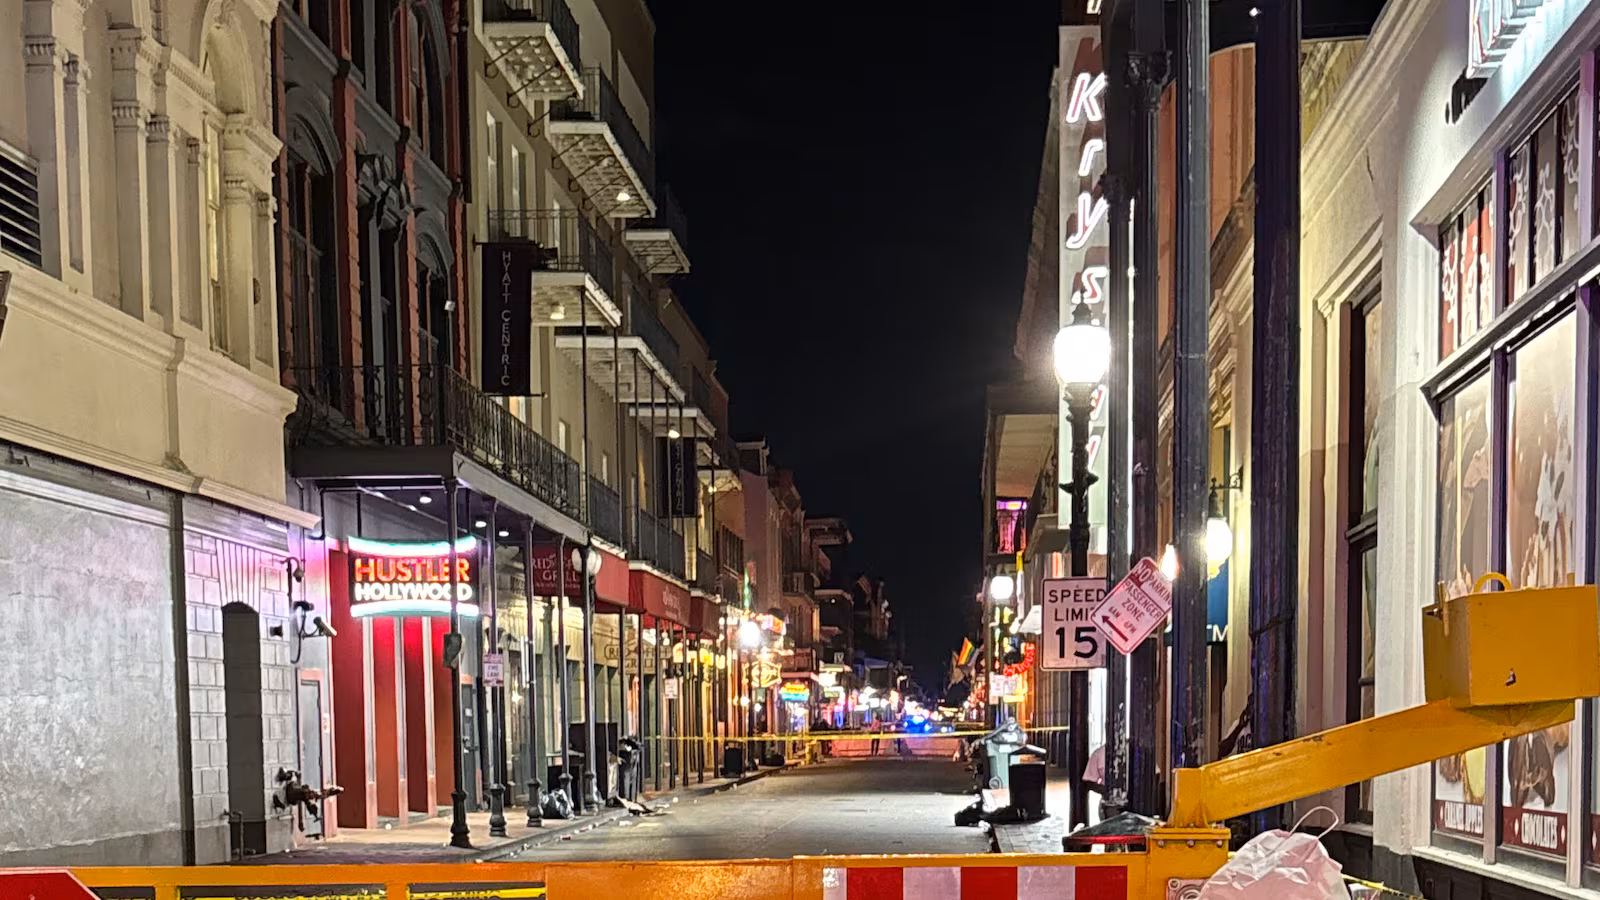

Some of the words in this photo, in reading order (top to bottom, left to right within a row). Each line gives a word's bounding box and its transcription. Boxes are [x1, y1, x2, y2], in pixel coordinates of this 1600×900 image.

[501, 251, 511, 303] HYATT
[501, 309, 511, 386] CENTRIC
[355, 558, 470, 582] HUSTLER
[1134, 562, 1152, 582] NO
[354, 582, 473, 601] HOLLYWOOD
[1048, 588, 1107, 604] SPEED
[1122, 579, 1162, 621] PASSENGER
[1054, 607, 1095, 622] LIMI
[1121, 597, 1145, 622] ZONE
[1055, 626, 1098, 659] 15
